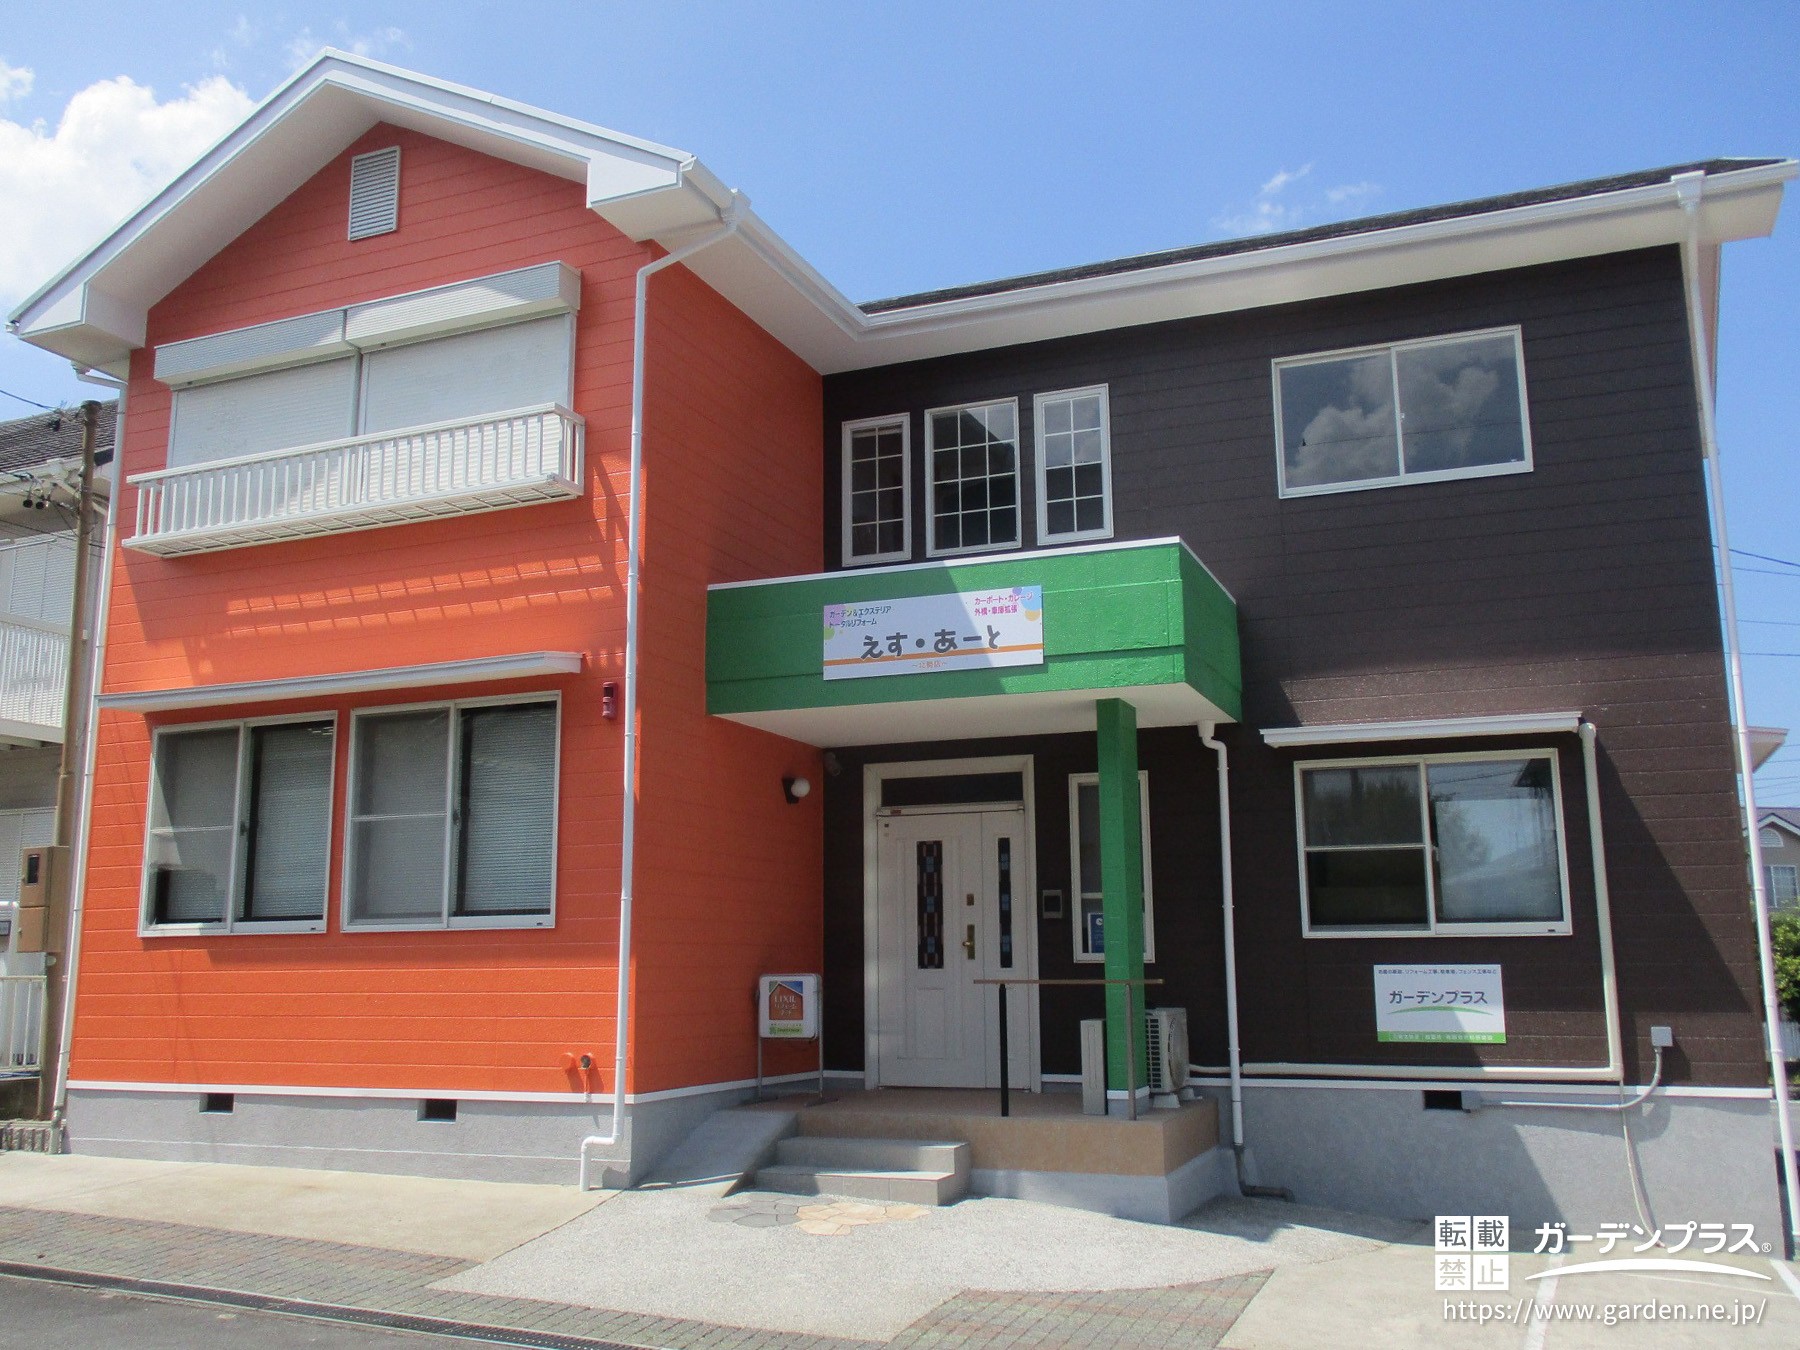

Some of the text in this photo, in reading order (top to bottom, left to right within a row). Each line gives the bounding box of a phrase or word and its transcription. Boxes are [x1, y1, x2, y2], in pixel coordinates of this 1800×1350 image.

[1389, 990, 1488, 1005] ガーデンプラス
